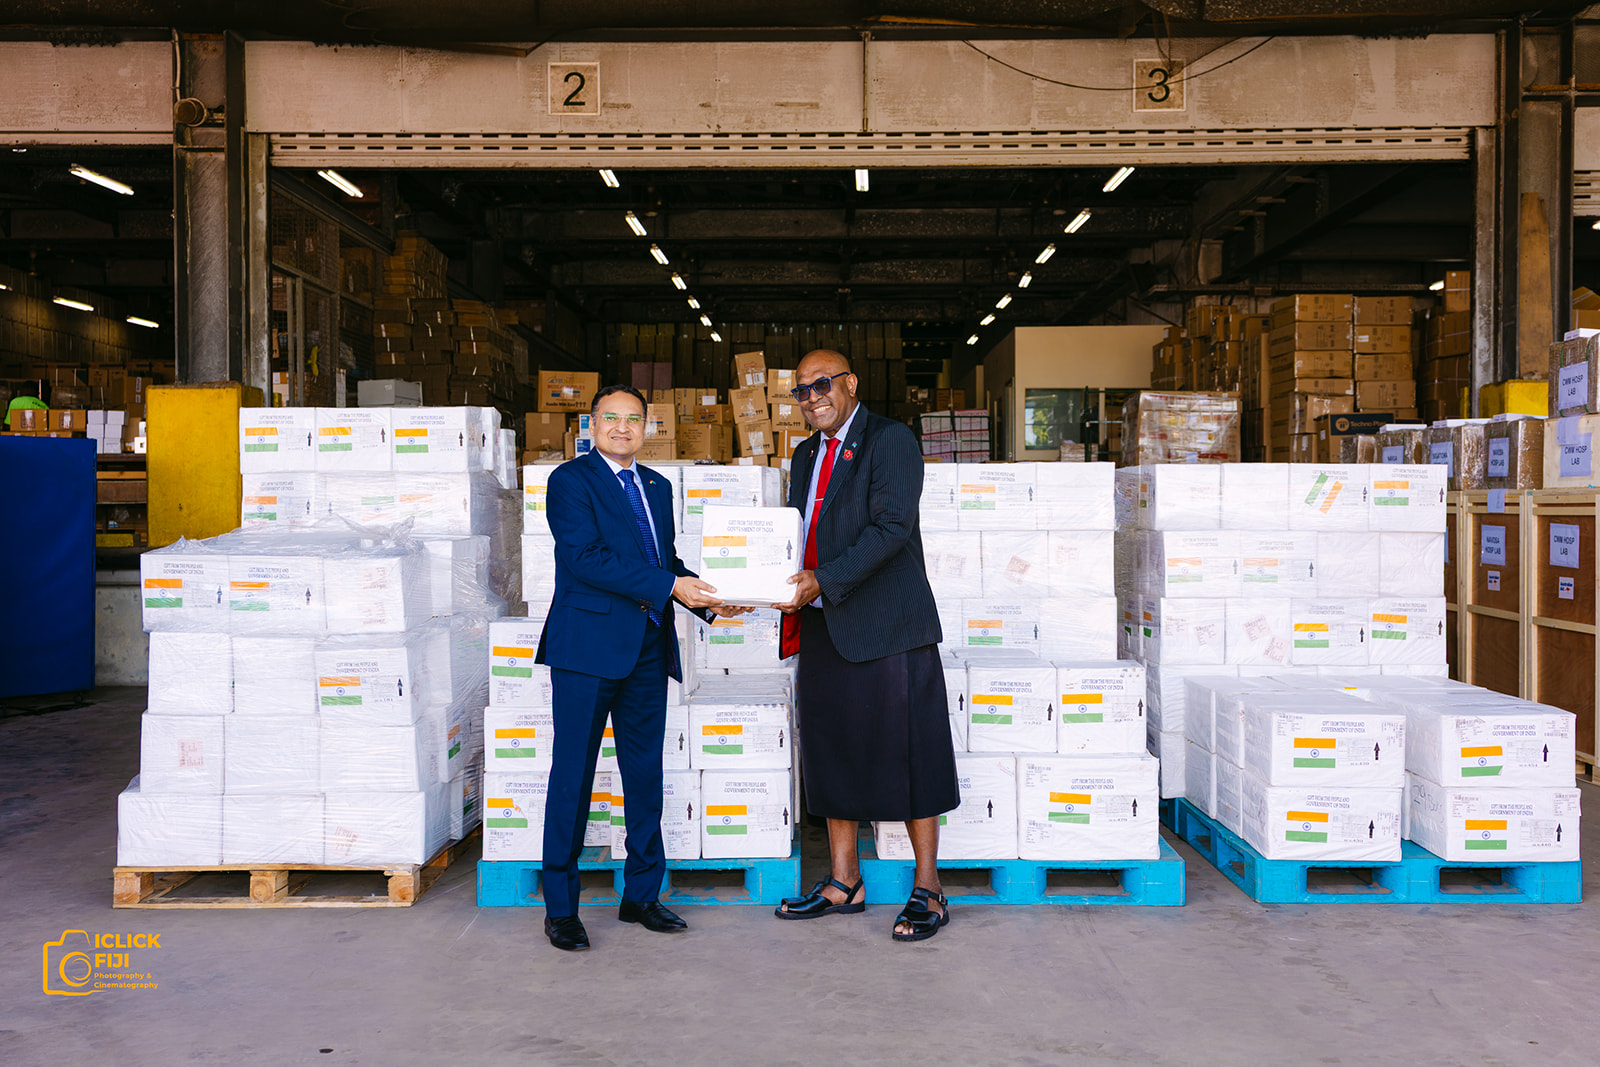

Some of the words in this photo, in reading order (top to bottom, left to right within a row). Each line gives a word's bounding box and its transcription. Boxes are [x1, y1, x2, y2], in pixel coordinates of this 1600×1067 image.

[563, 72, 586, 106] 2
[1148, 67, 1170, 102] 3
[1572, 374, 1584, 383] HOSP
[1567, 387, 1576, 396] LAB
[1575, 445, 1588, 454] HOSP
[1571, 457, 1580, 465] LAB
[1564, 536, 1575, 545] HOSP
[1560, 547, 1569, 556] LAB
